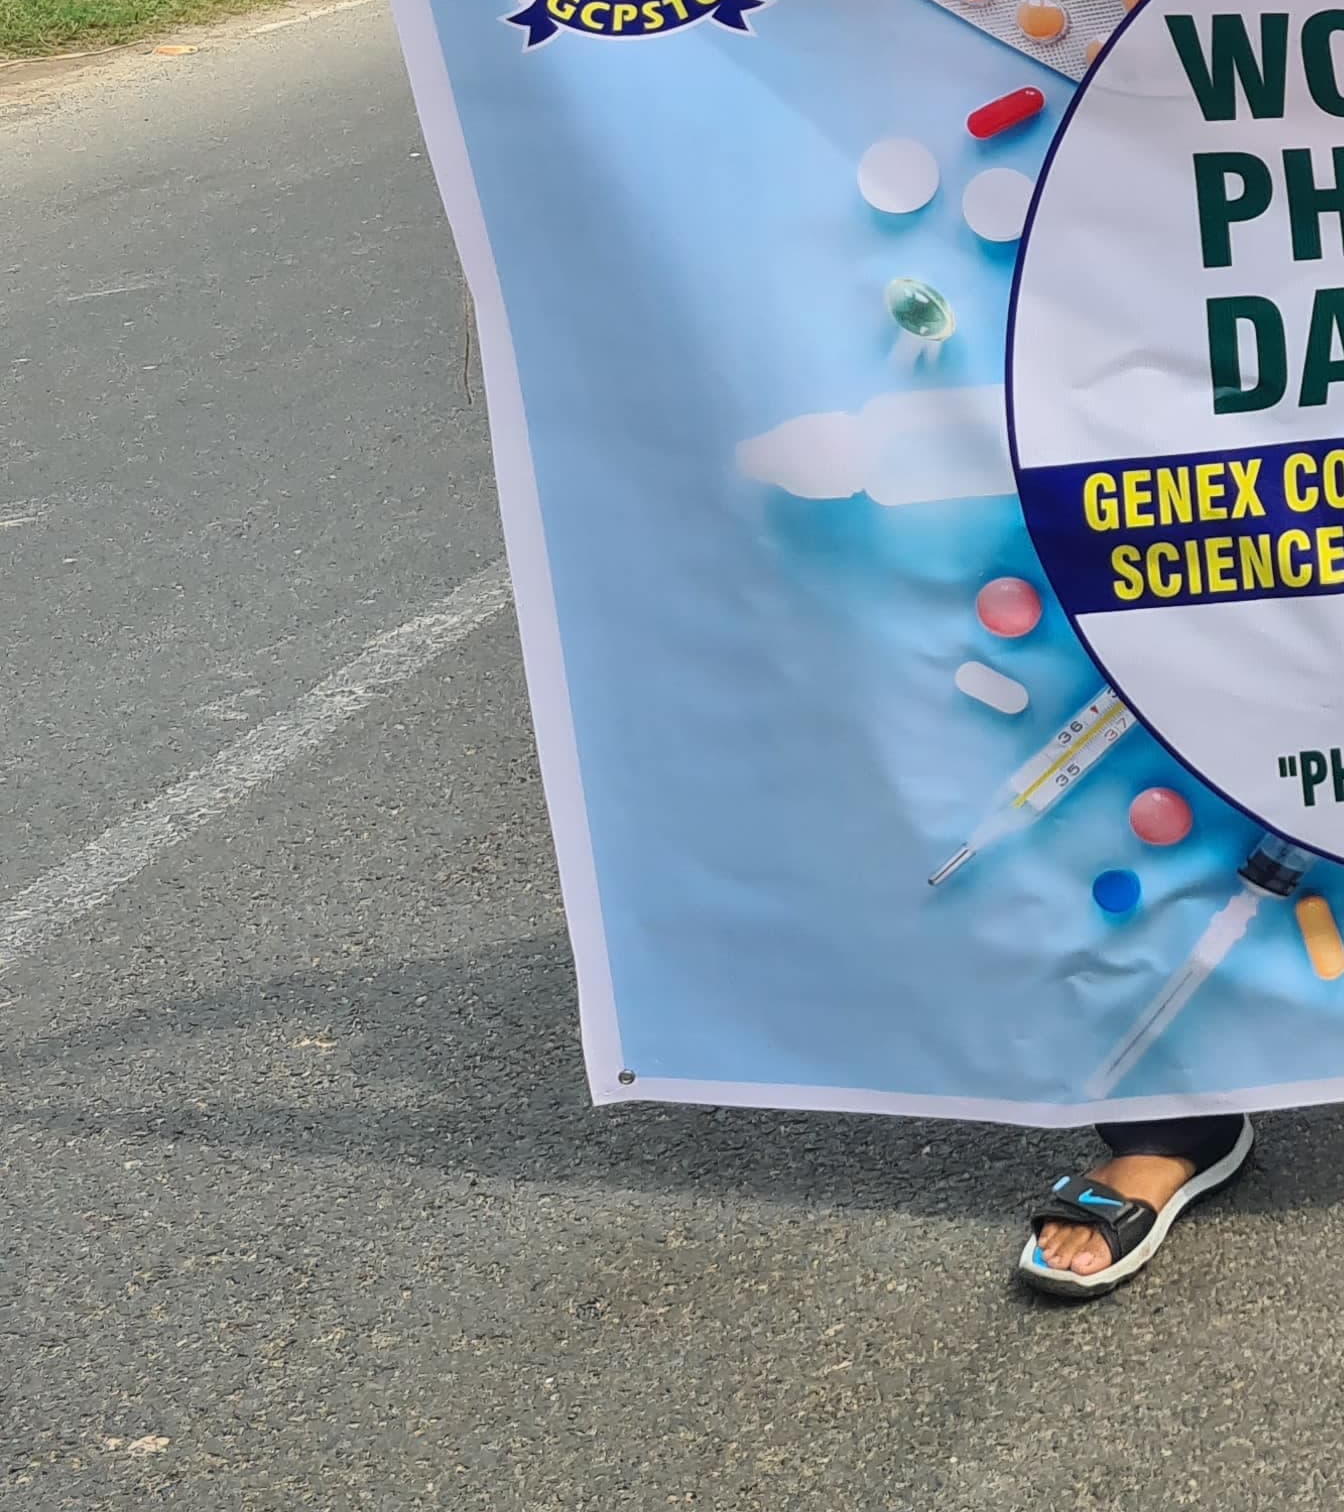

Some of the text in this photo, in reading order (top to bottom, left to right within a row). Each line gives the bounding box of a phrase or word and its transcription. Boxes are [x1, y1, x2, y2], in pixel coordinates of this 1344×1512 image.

[1083, 458, 1262, 536] GENEX
[1058, 720, 1084, 745] 36
[1056, 763, 1081, 787] 35
